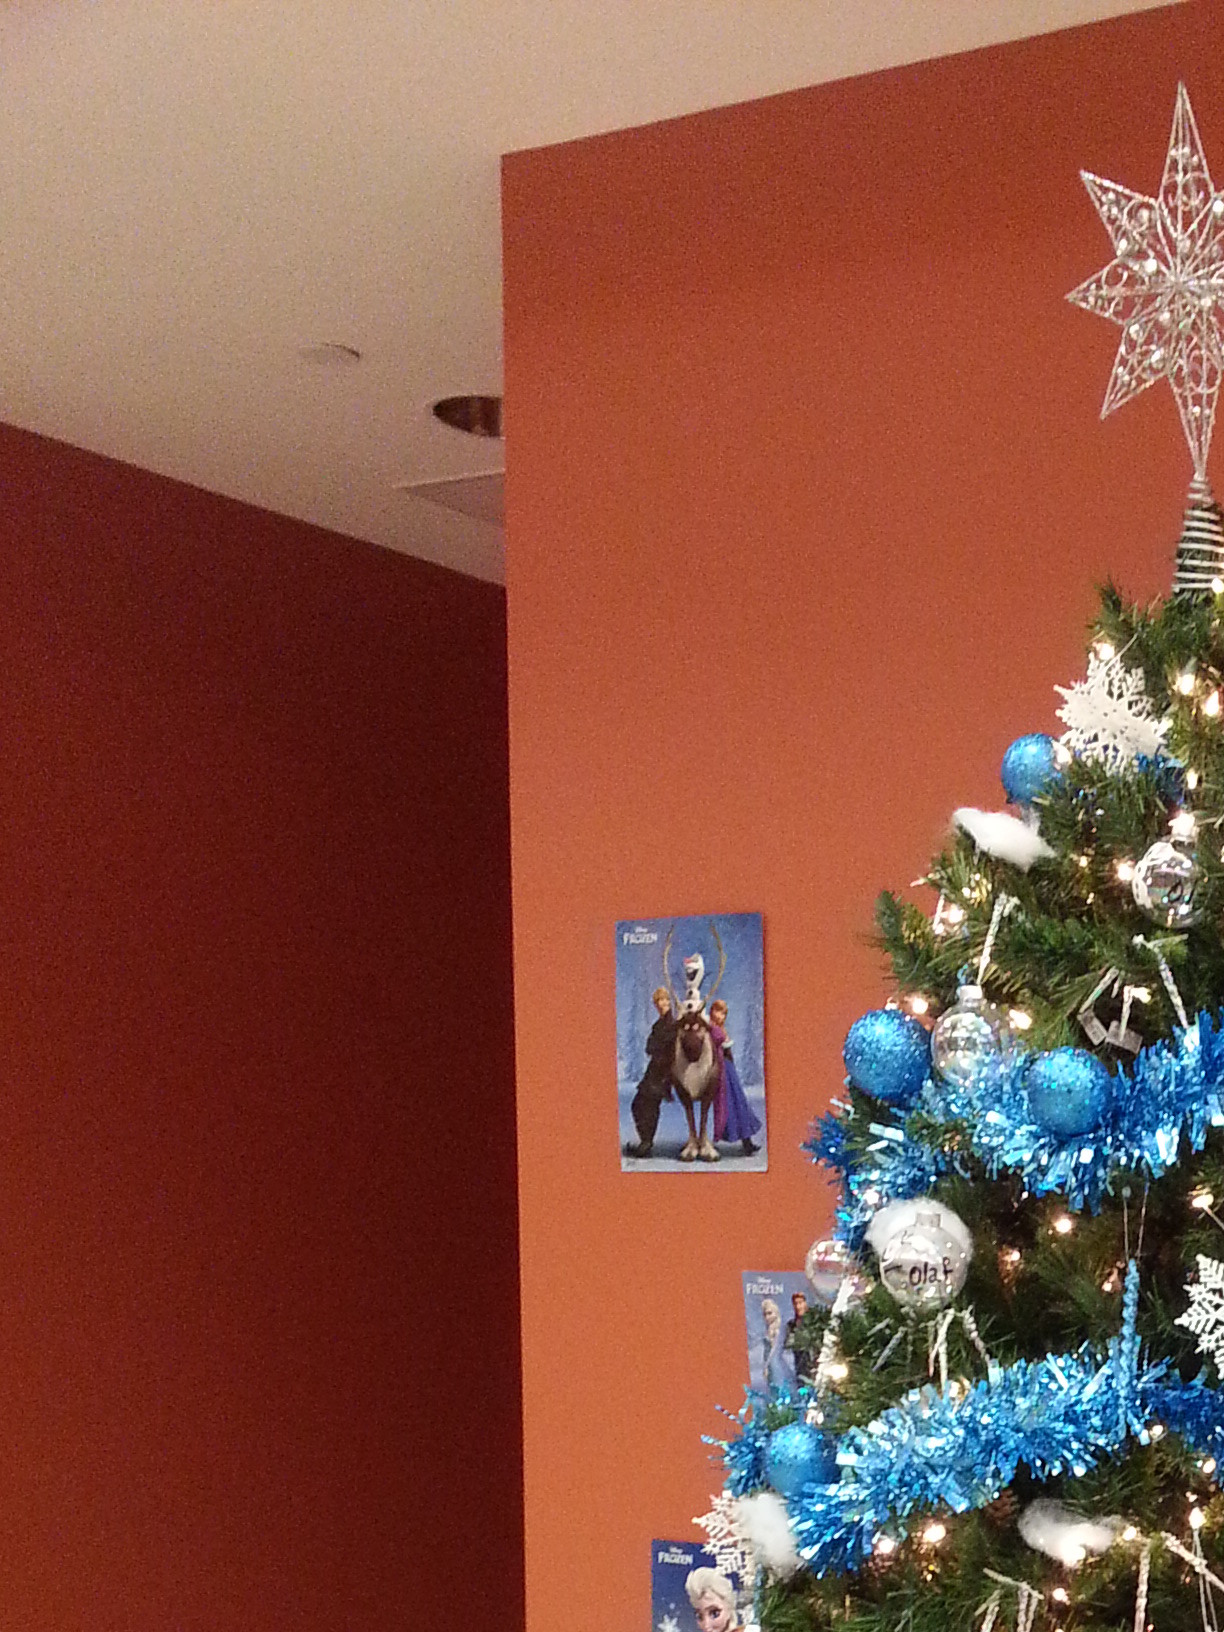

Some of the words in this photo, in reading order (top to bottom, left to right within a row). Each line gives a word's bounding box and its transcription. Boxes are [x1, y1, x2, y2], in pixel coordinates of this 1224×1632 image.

[909, 1256, 954, 1286] Olaf
[746, 1283, 784, 1295] FROZEN
[657, 1551, 694, 1566] FROZEN
